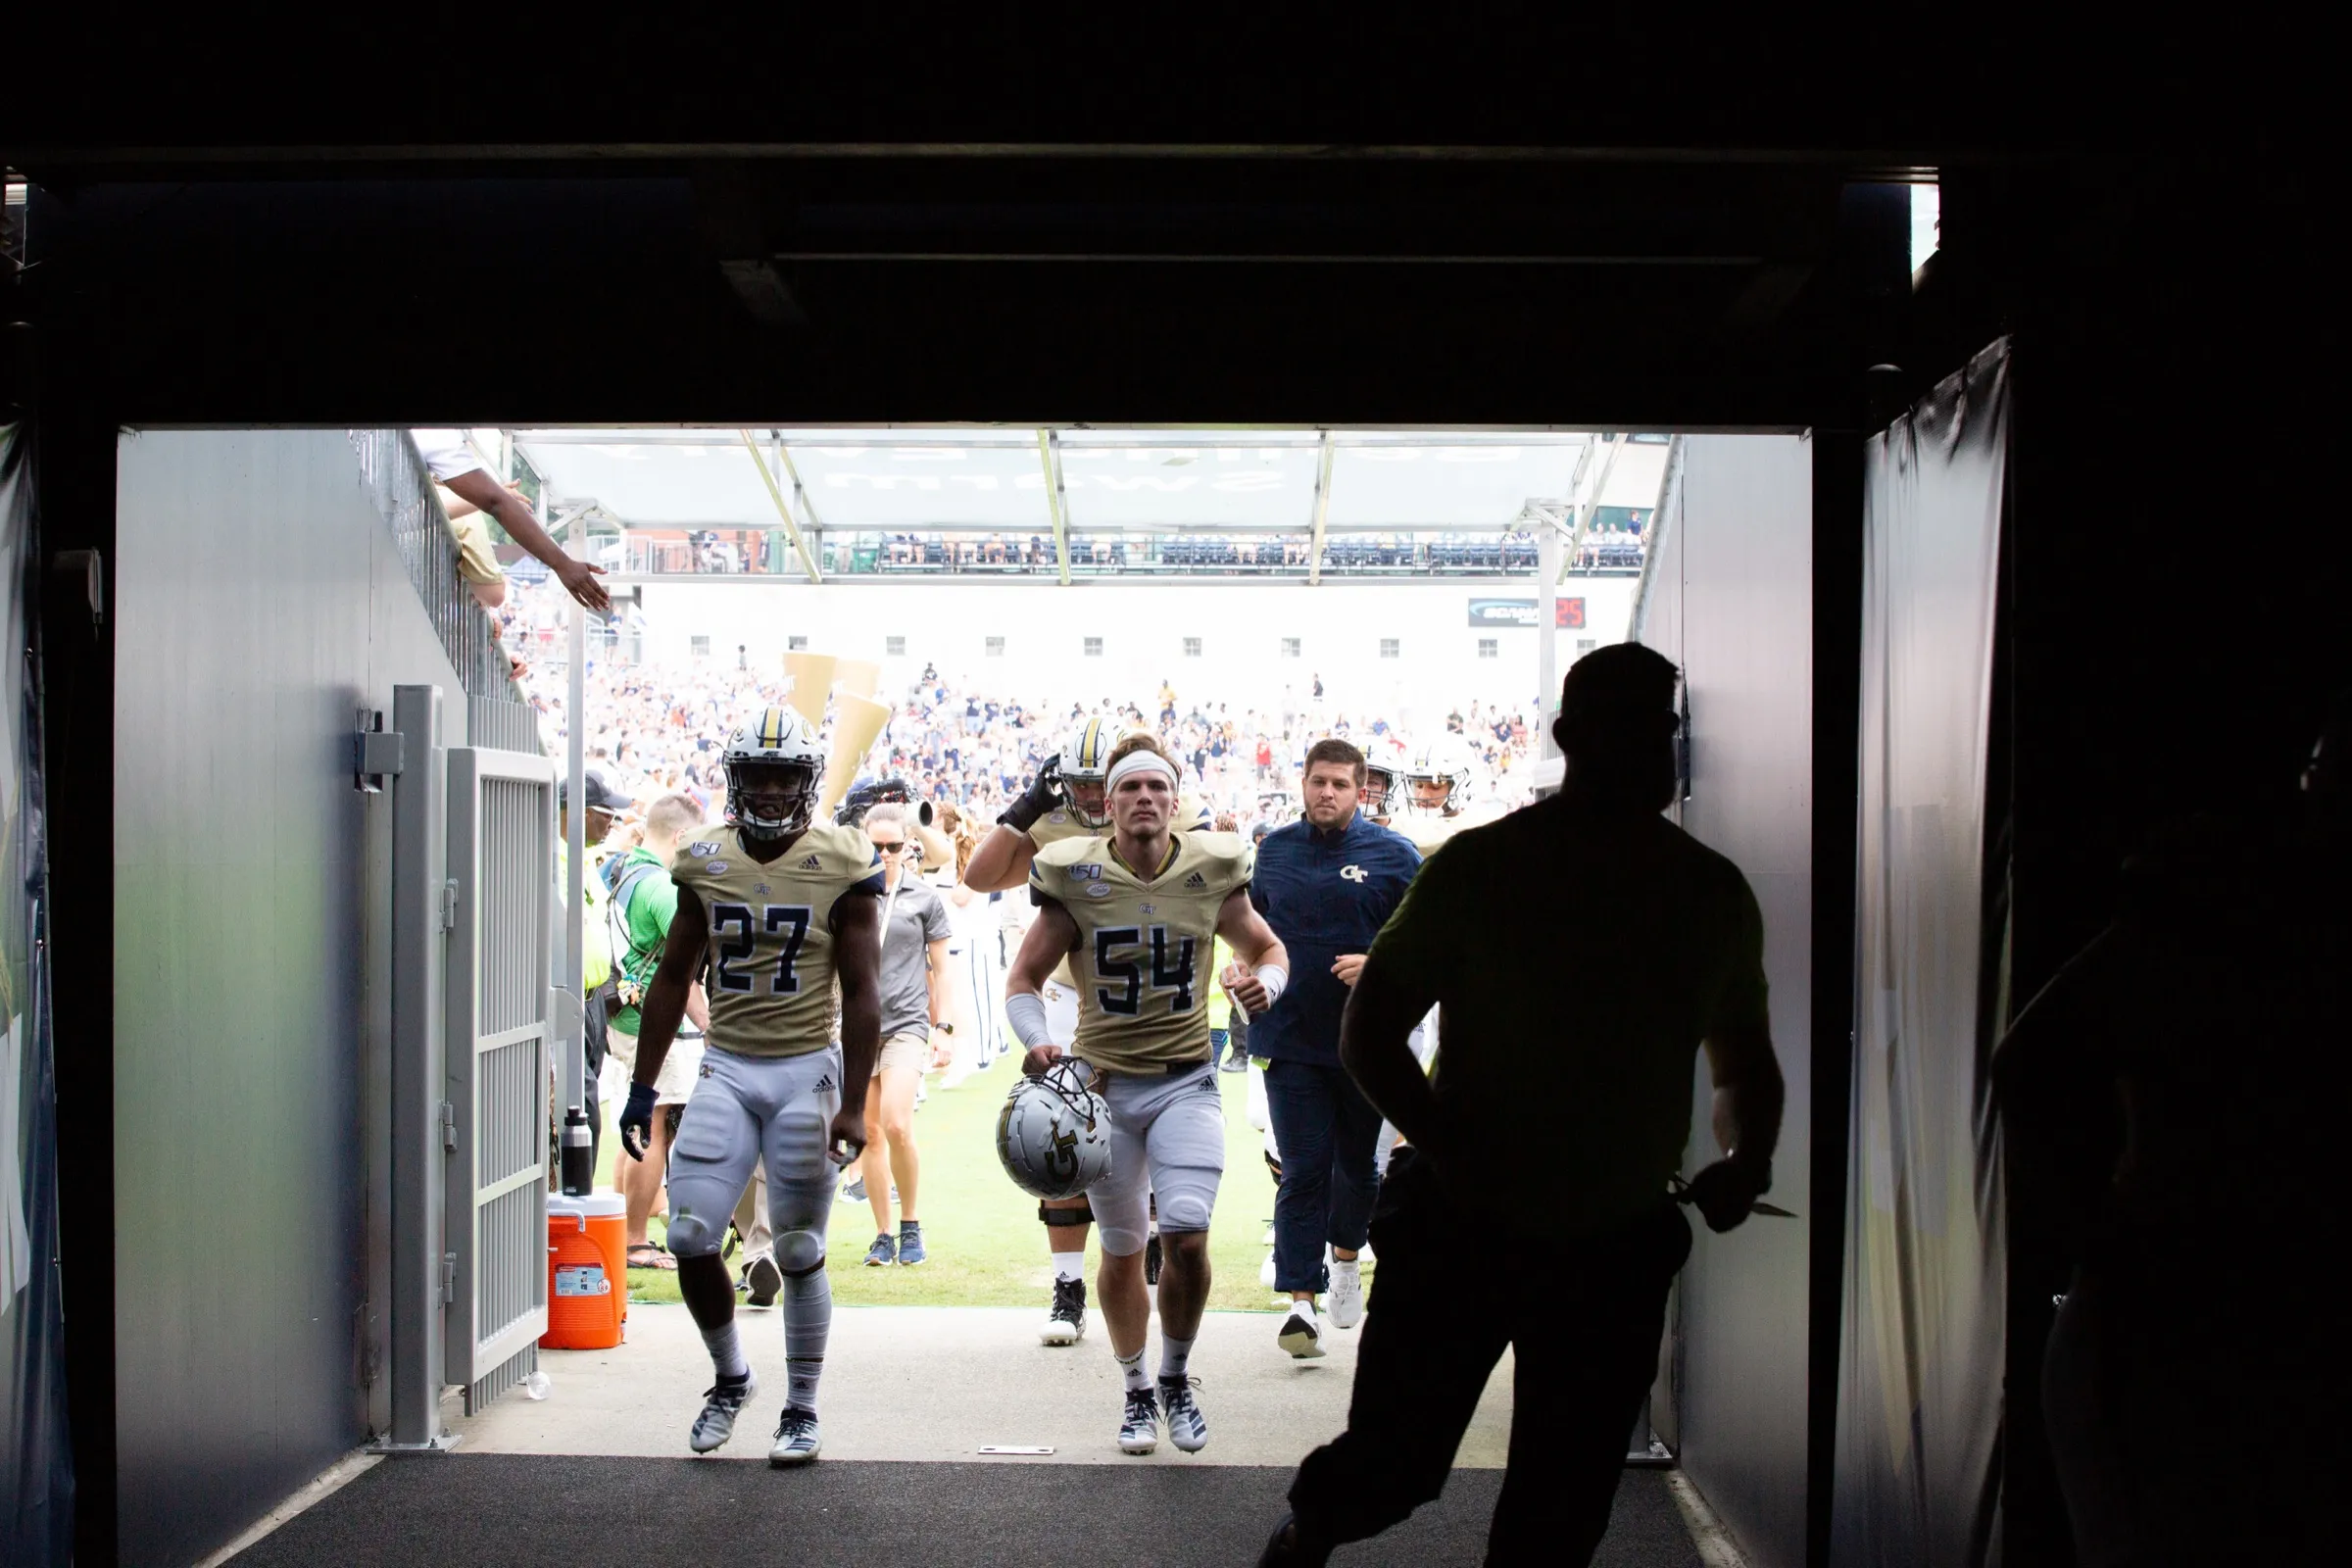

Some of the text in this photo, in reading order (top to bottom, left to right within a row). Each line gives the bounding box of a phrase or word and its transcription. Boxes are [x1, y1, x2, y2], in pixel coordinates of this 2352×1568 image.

[1555, 598, 1583, 626] 25
[1069, 863, 1102, 880] 150
[710, 902, 813, 995] 27
[1093, 923, 1196, 1015] 54
